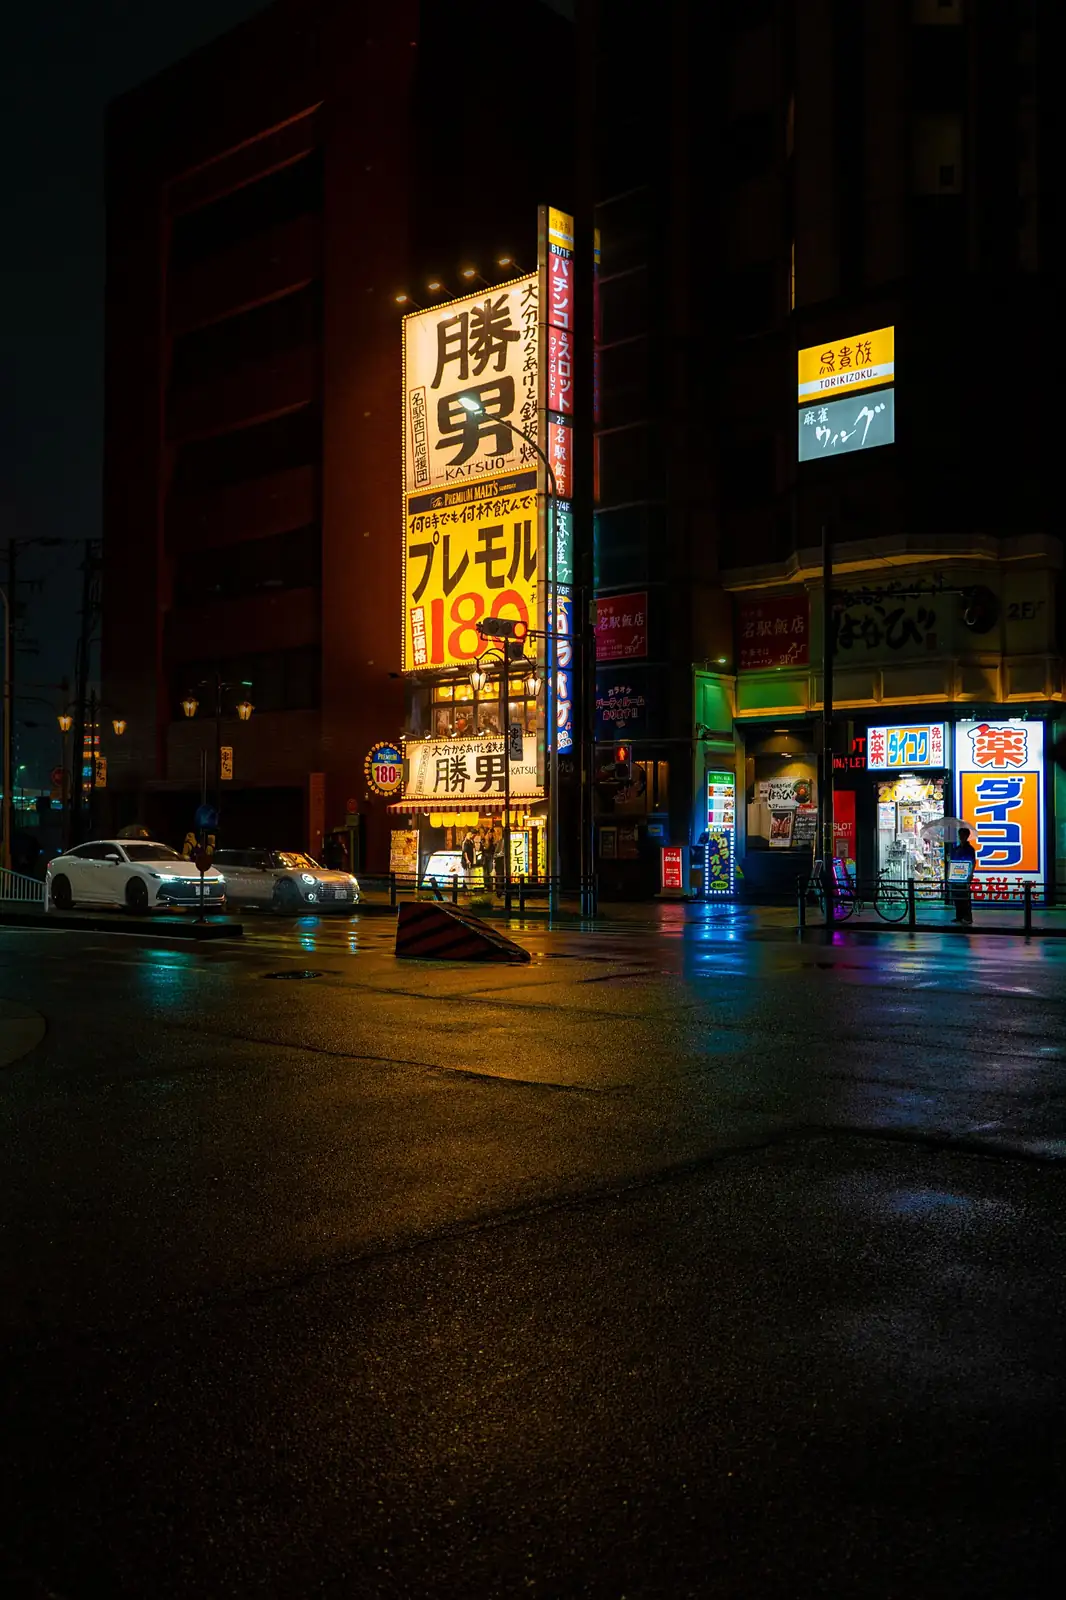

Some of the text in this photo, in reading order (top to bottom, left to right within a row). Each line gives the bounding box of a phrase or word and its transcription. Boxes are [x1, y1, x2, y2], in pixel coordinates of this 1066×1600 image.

[551, 244, 570, 258] B1/1F
[553, 257, 569, 328] パチンコ
[518, 283, 538, 464] 大分からあげと鉄板焼
[819, 340, 872, 375] 鳥貴族
[431, 294, 520, 466] 勝男
[820, 368, 872, 389] TORIKIZOKU
[556, 415, 565, 425] 2F
[804, 407, 829, 425] 麻雀
[815, 403, 885, 447] ウィング
[411, 392, 428, 483] 名駅西口応援団
[554, 428, 566, 495] 名駅飯店
[444, 487, 473, 506] PREMIUM
[474, 481, 499, 500] MALT'S
[409, 520, 537, 604] プレモル
[431, 589, 529, 664] 180
[599, 611, 644, 630] 名駅飯店
[742, 615, 804, 639] 名駅飯店
[870, 729, 884, 765] 薬
[889, 730, 930, 764] ダイコク
[932, 727, 942, 752] 免税
[968, 724, 1028, 768] 薬
[433, 754, 505, 793] 勝男
[833, 822, 853, 831] SLOT
[975, 776, 1025, 868] ダイコク
